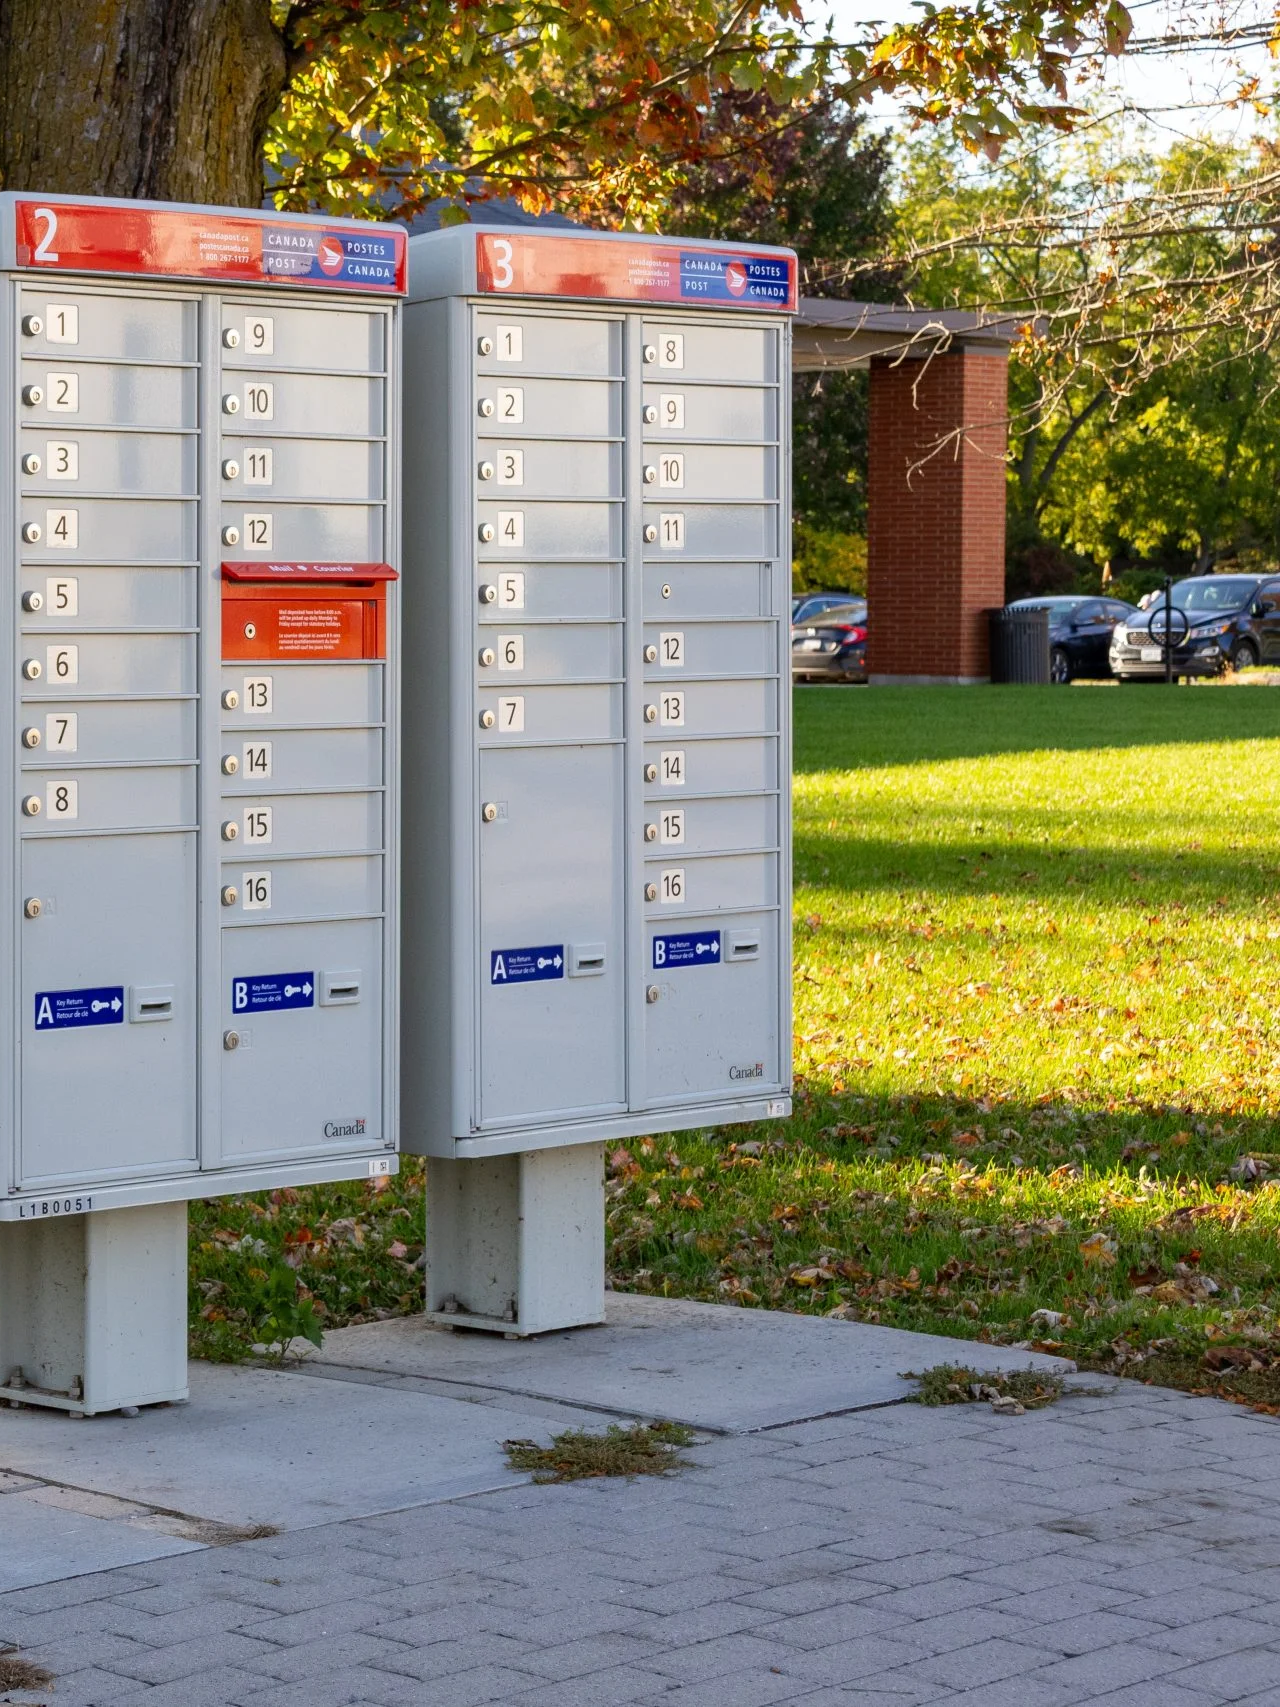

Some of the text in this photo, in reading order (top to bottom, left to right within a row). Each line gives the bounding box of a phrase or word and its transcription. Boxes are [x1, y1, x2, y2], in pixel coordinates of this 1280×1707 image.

[33, 208, 59, 262] 2
[200, 232, 249, 241] canadapost.ca
[268, 234, 314, 248] CANADA
[200, 243, 249, 253] postescanada.ca
[220, 254, 249, 264] 267-1177
[348, 242, 385, 256] POSTES
[268, 257, 296, 269] POST
[348, 264, 390, 278] CANADA
[492, 240, 513, 289] 3
[684, 259, 723, 272] CANADA
[749, 265, 780, 277] POSTES
[685, 281, 708, 291] POST
[750, 286, 785, 297] CANADA
[57, 311, 65, 337] 1
[253, 323, 265, 348] 9
[505, 332, 512, 355] 1
[665, 340, 676, 363] 8
[56, 379, 69, 405] 2
[248, 388, 269, 414] 10
[504, 394, 515, 417] 2
[666, 400, 677, 423] 9
[56, 447, 69, 473] 3
[248, 454, 266, 478] 11
[504, 455, 515, 479] 3
[663, 459, 680, 482] 10
[54, 515, 69, 541] 4
[248, 519, 268, 544] 12
[504, 517, 516, 540] 4
[664, 519, 679, 542] 11
[56, 583, 68, 609] 5
[506, 579, 516, 602] 5
[505, 640, 516, 664] 6
[663, 637, 680, 660] 12
[56, 651, 69, 677] 6
[247, 682, 268, 708] 13
[506, 702, 517, 726] 7
[663, 697, 680, 720] 13
[55, 719, 68, 744] 7
[246, 748, 268, 772] 14
[663, 756, 681, 779] 14
[55, 786, 69, 812] 8
[247, 812, 268, 838] 15
[663, 815, 681, 838] 15
[246, 877, 267, 902] 16
[663, 874, 681, 897] 16
[655, 941, 666, 965] B
[493, 955, 507, 980] A
[236, 982, 248, 1009] B
[37, 997, 54, 1024] A
[729, 1064, 763, 1080] Canada
[324, 1119, 365, 1138] Canada
